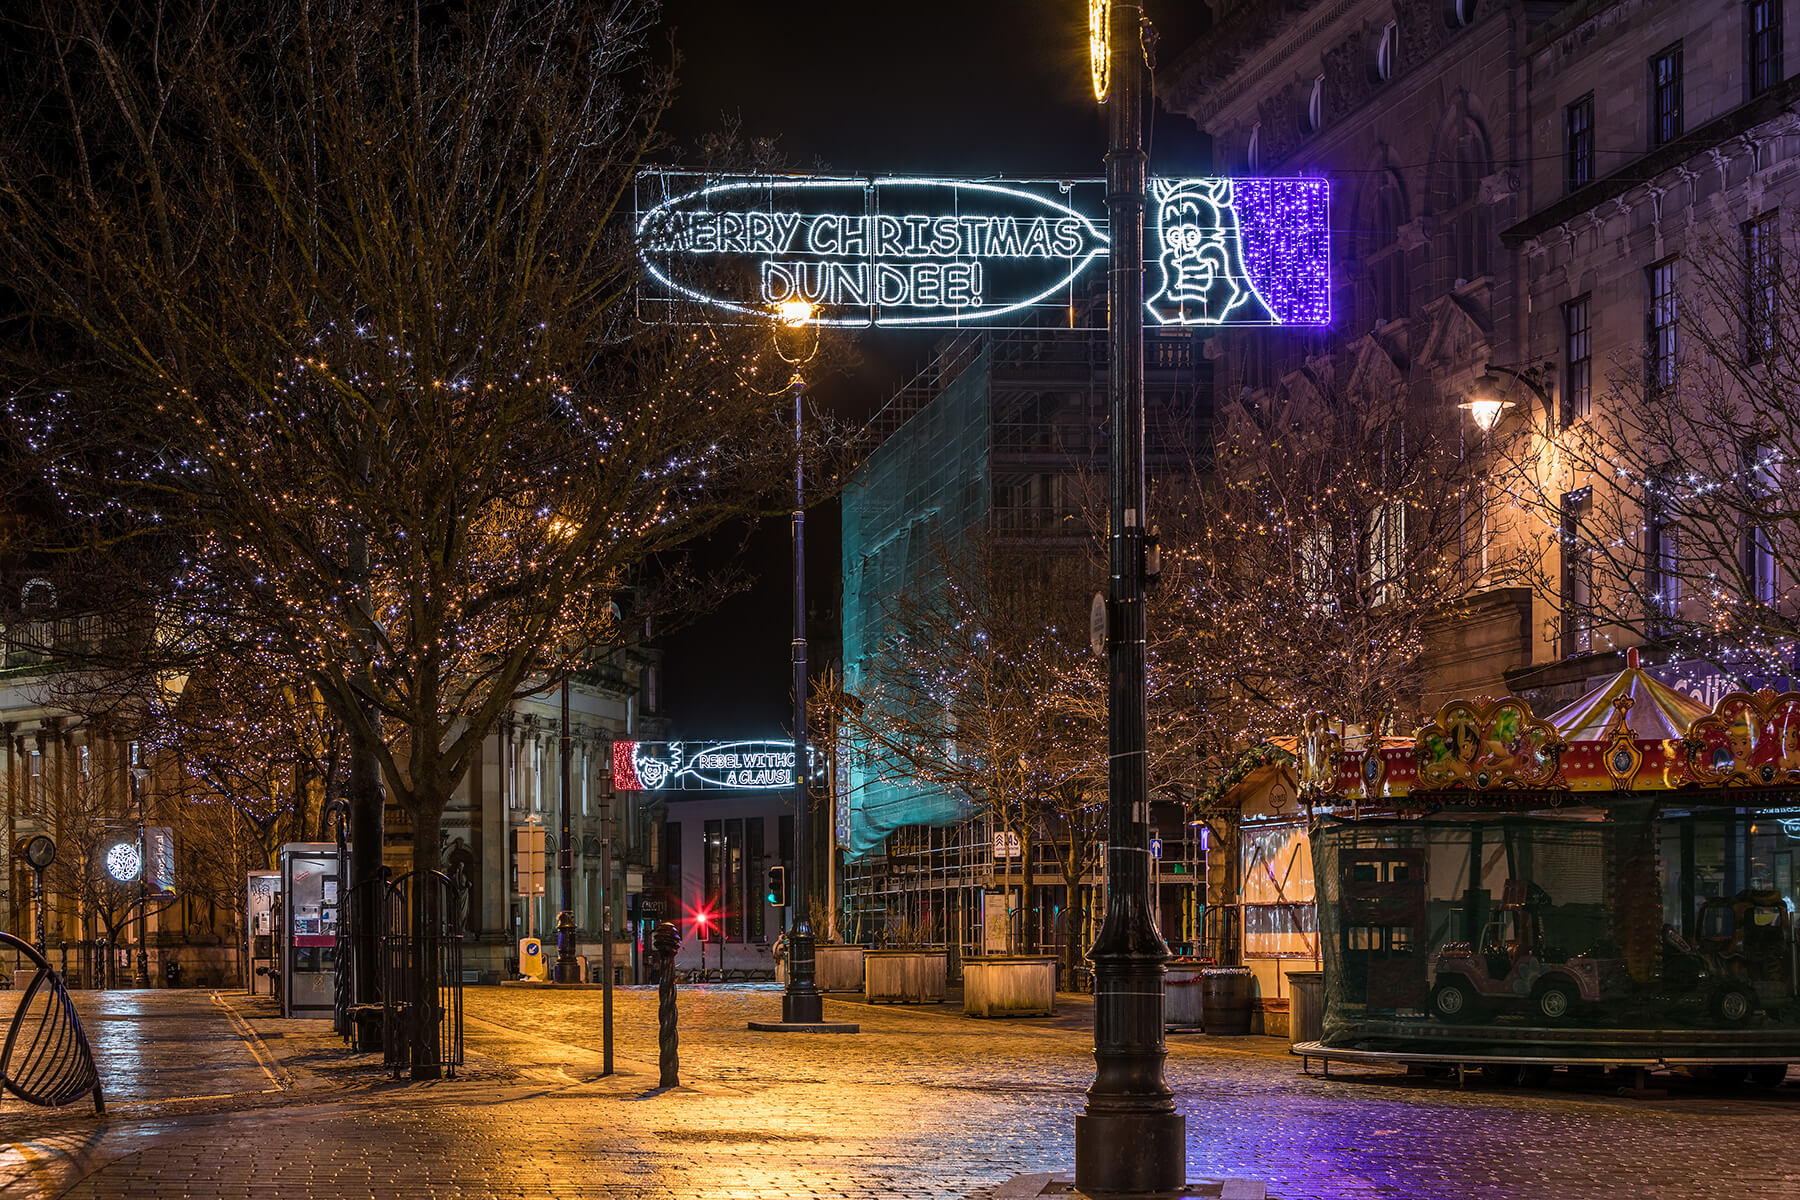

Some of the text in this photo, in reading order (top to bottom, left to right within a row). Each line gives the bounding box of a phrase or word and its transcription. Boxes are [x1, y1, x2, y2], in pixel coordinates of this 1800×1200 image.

[652, 210, 1084, 257] MERRY CHRISTMAS
[761, 261, 983, 307] DUNDEE!
[700, 754, 741, 768] REBEL
[727, 770, 791, 784] A CLAUS!
